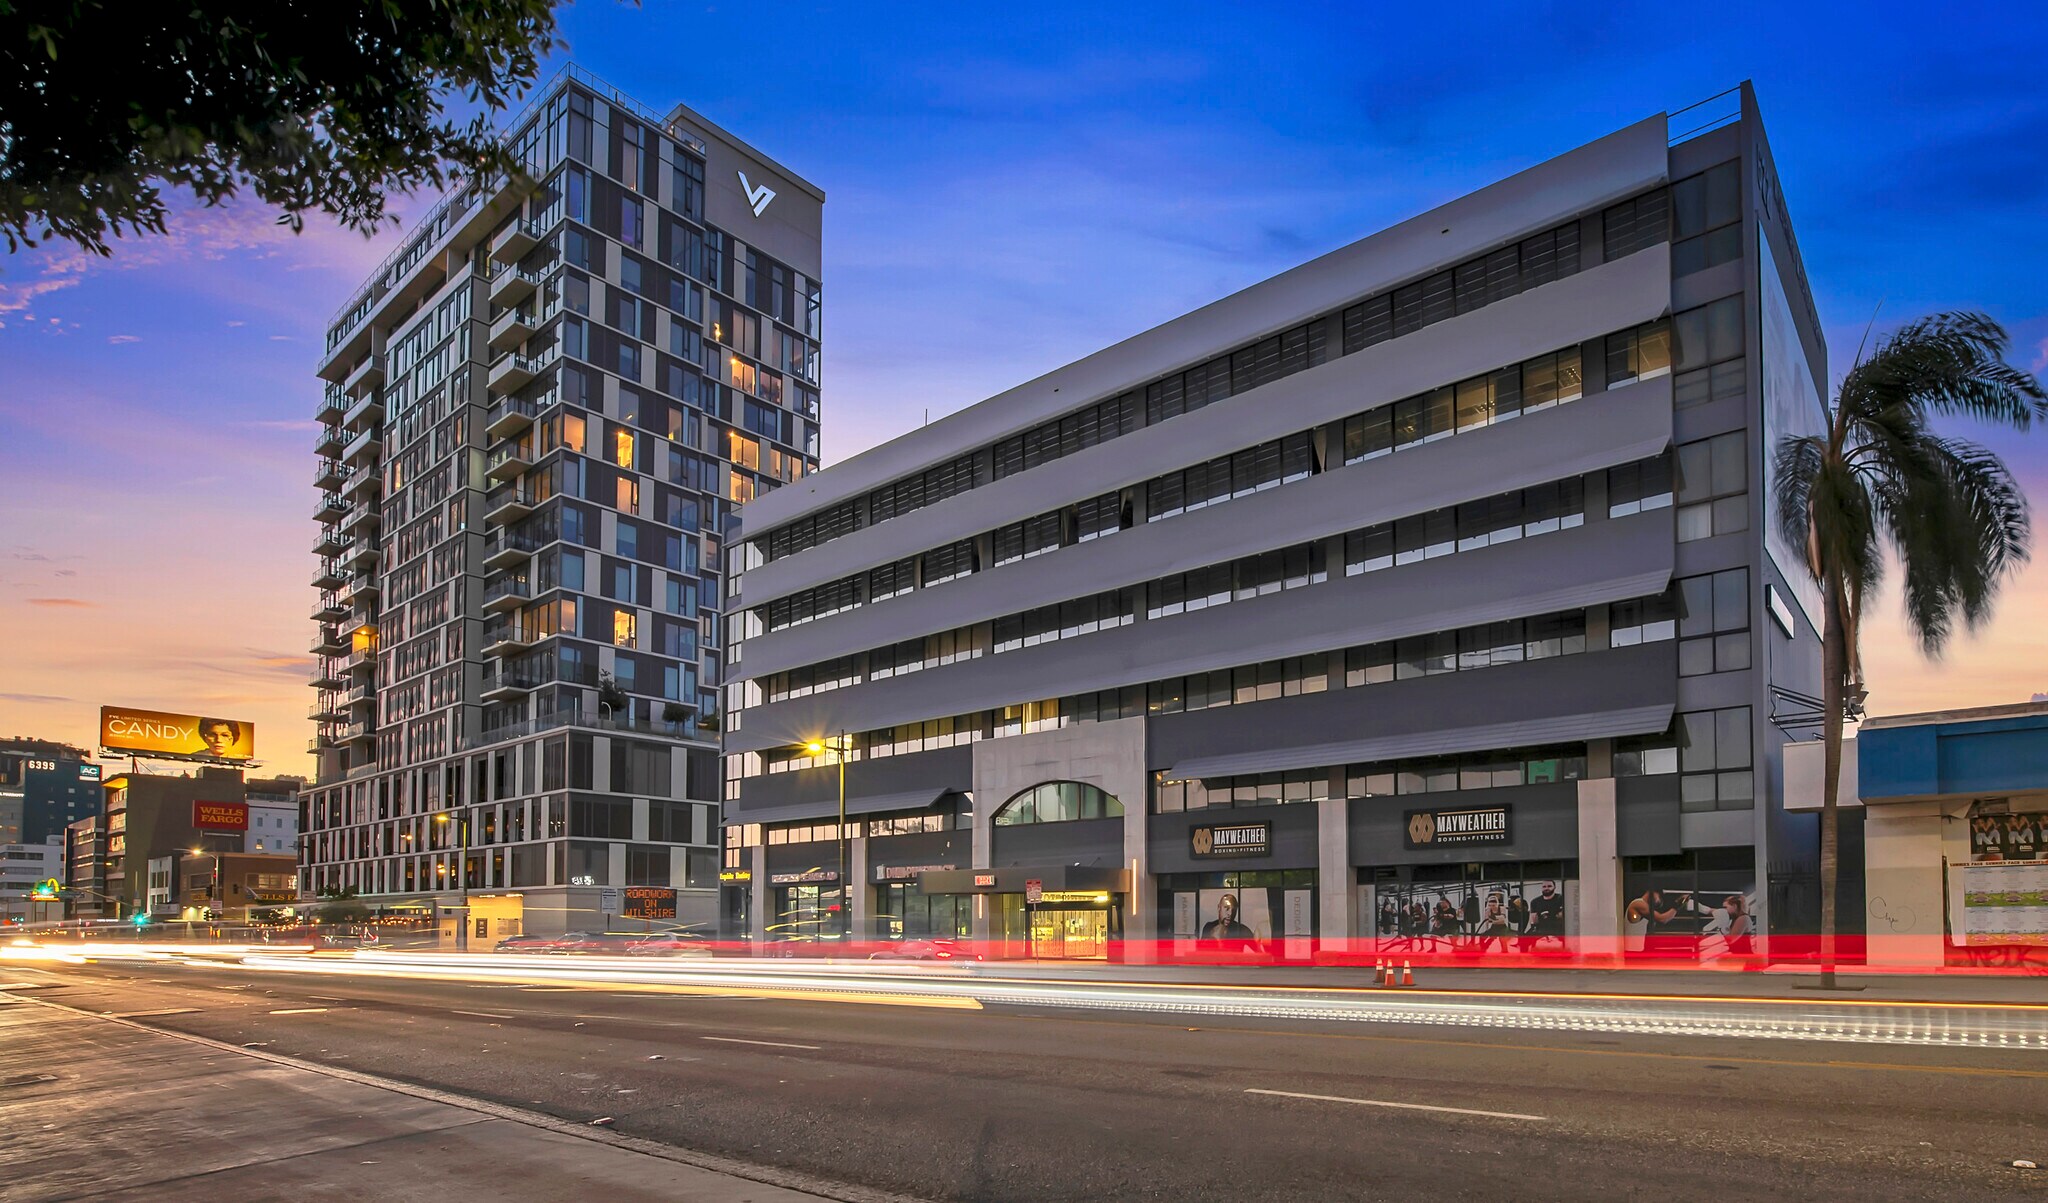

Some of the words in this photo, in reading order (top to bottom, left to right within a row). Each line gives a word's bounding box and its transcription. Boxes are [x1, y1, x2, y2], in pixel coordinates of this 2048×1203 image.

[108, 719, 194, 741] CANDY
[28, 760, 55, 771] 6399
[81, 767, 98, 775] AC
[200, 806, 244, 816] WELLS
[201, 815, 243, 824] FARGO
[1437, 812, 1506, 832] MAYWEATHER
[1213, 828, 1266, 845] MAYWEATHER
[626, 889, 675, 899] ROADWORK
[644, 900, 657, 908] ON
[626, 908, 675, 918] WILSHIRE
